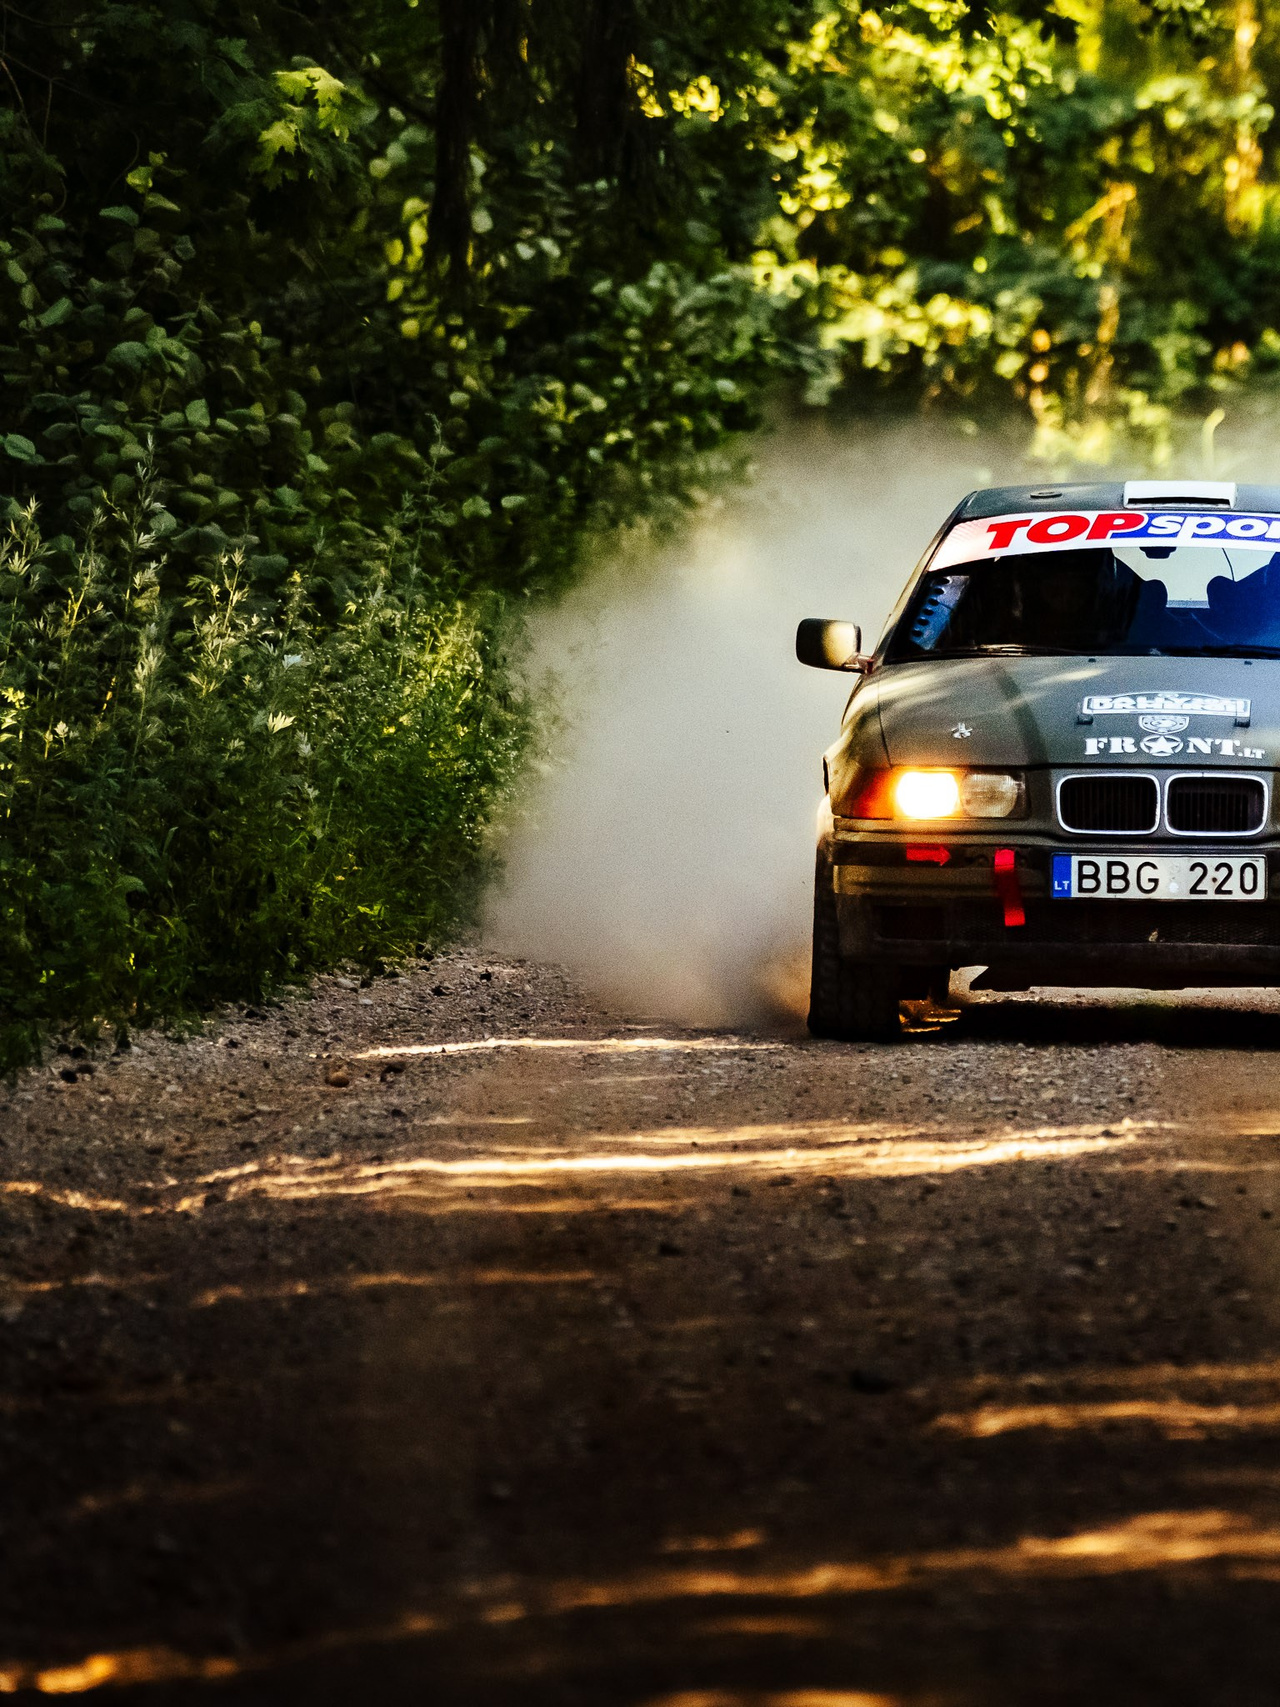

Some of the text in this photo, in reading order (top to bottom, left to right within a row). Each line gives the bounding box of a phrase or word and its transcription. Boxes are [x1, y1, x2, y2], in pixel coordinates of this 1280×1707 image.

[1054, 880, 1070, 891] LT
[1077, 860, 1258, 896] BBG 220
